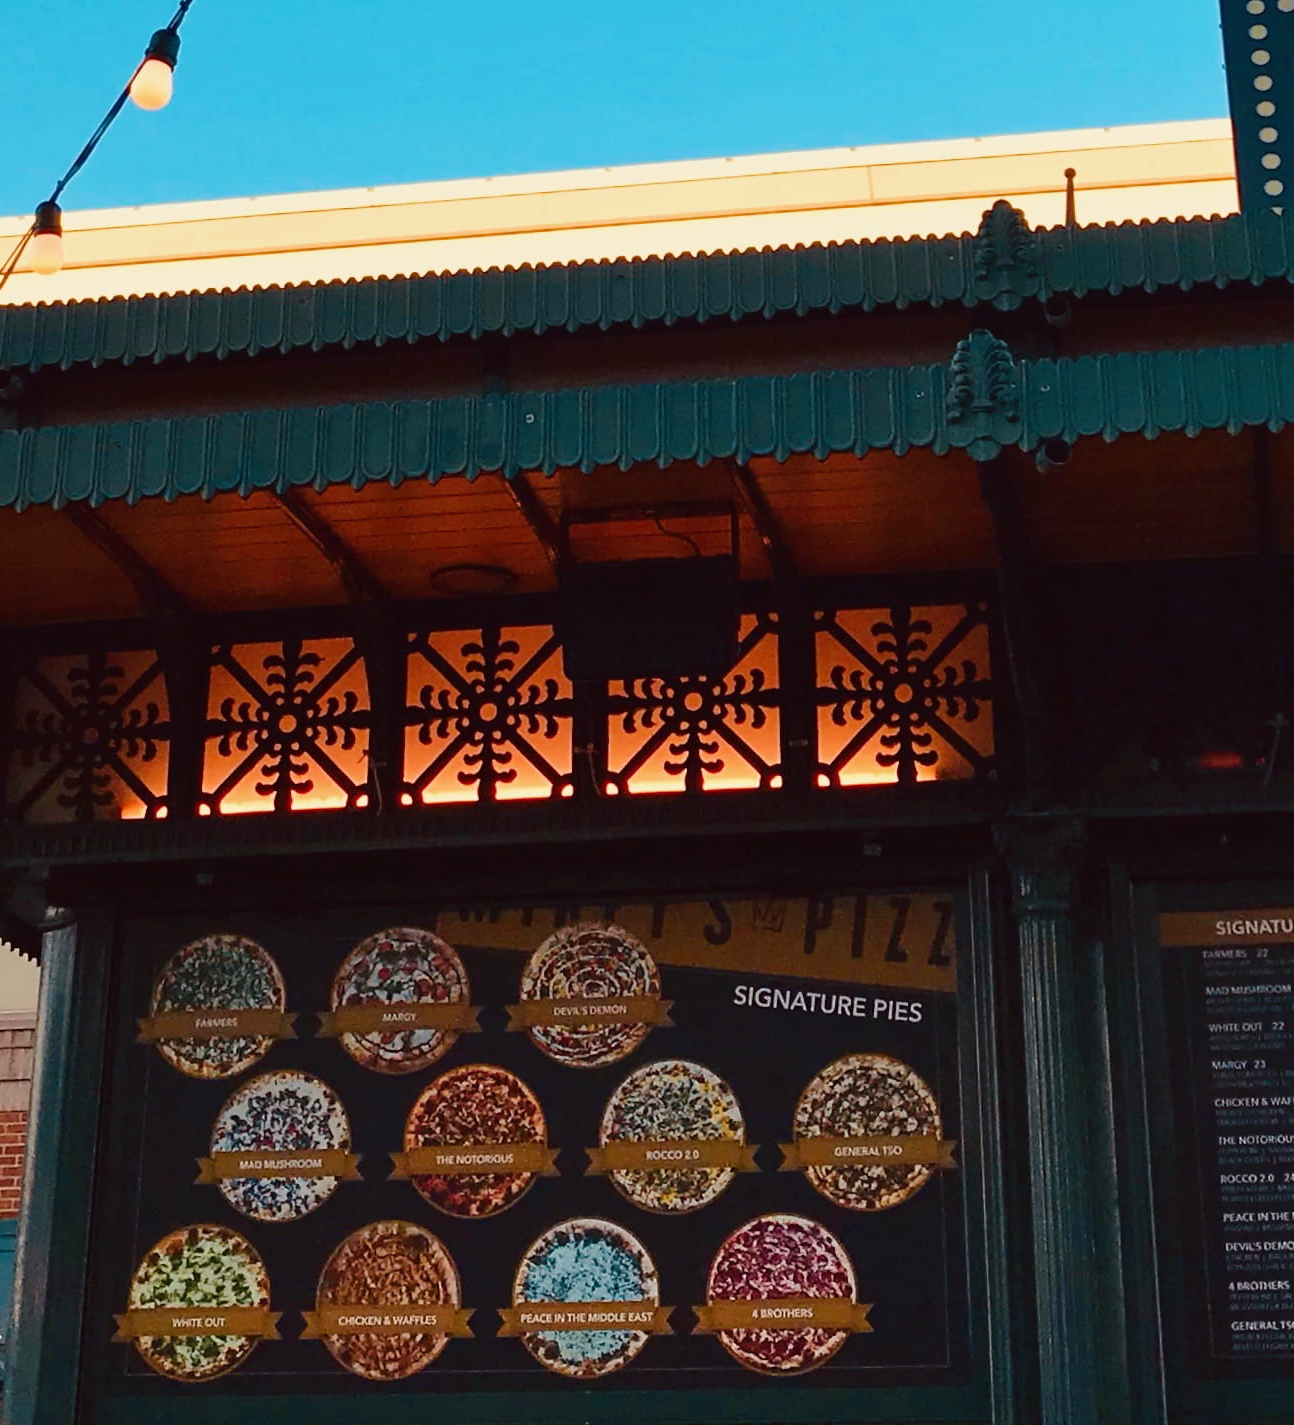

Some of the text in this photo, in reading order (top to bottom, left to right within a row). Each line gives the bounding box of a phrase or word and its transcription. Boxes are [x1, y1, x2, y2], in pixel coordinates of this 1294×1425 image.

[1202, 949, 1248, 960] FARMERS
[1205, 985, 1228, 996] MAD
[1230, 984, 1292, 995] MUSHROOM
[553, 1003, 627, 1016] DEVIL'S DEMON
[732, 984, 924, 1024] SIGNATURE PIES
[195, 1017, 238, 1029] FARMERS
[382, 1013, 418, 1023] MARGY
[1208, 1021, 1285, 1033] WHITE OUT 22
[1211, 1060, 1247, 1071] MARGY
[1214, 1097, 1260, 1108] CHICKEN
[1260, 1097, 1269, 1107] &
[1218, 1135, 1237, 1146] THE
[646, 1149, 700, 1160] ROCCO 2.0
[834, 1144, 902, 1156] GENERAL TSO
[239, 1158, 322, 1169] MAD MUSHROOM
[435, 1153, 514, 1165] THE NOTORIOUS
[1220, 1173, 1258, 1184] ROCCO
[1259, 1173, 1275, 1183] 2.0
[1222, 1212, 1256, 1223] PEACE
[1257, 1212, 1269, 1222] IN
[1269, 1211, 1289, 1222] THE
[1225, 1241, 1263, 1252] DEVIL'S
[1227, 1281, 1236, 1292] 4
[1237, 1280, 1291, 1291] BROTHERS
[520, 1310, 653, 1324] PEACE IN THE MIDDLE EAST
[751, 1307, 813, 1319] 4 BROTHERS
[171, 1317, 226, 1328] WHITE OUT
[338, 1314, 438, 1327] CHICKEN & WAFFLES
[1231, 1320, 1280, 1332] GENERAL
